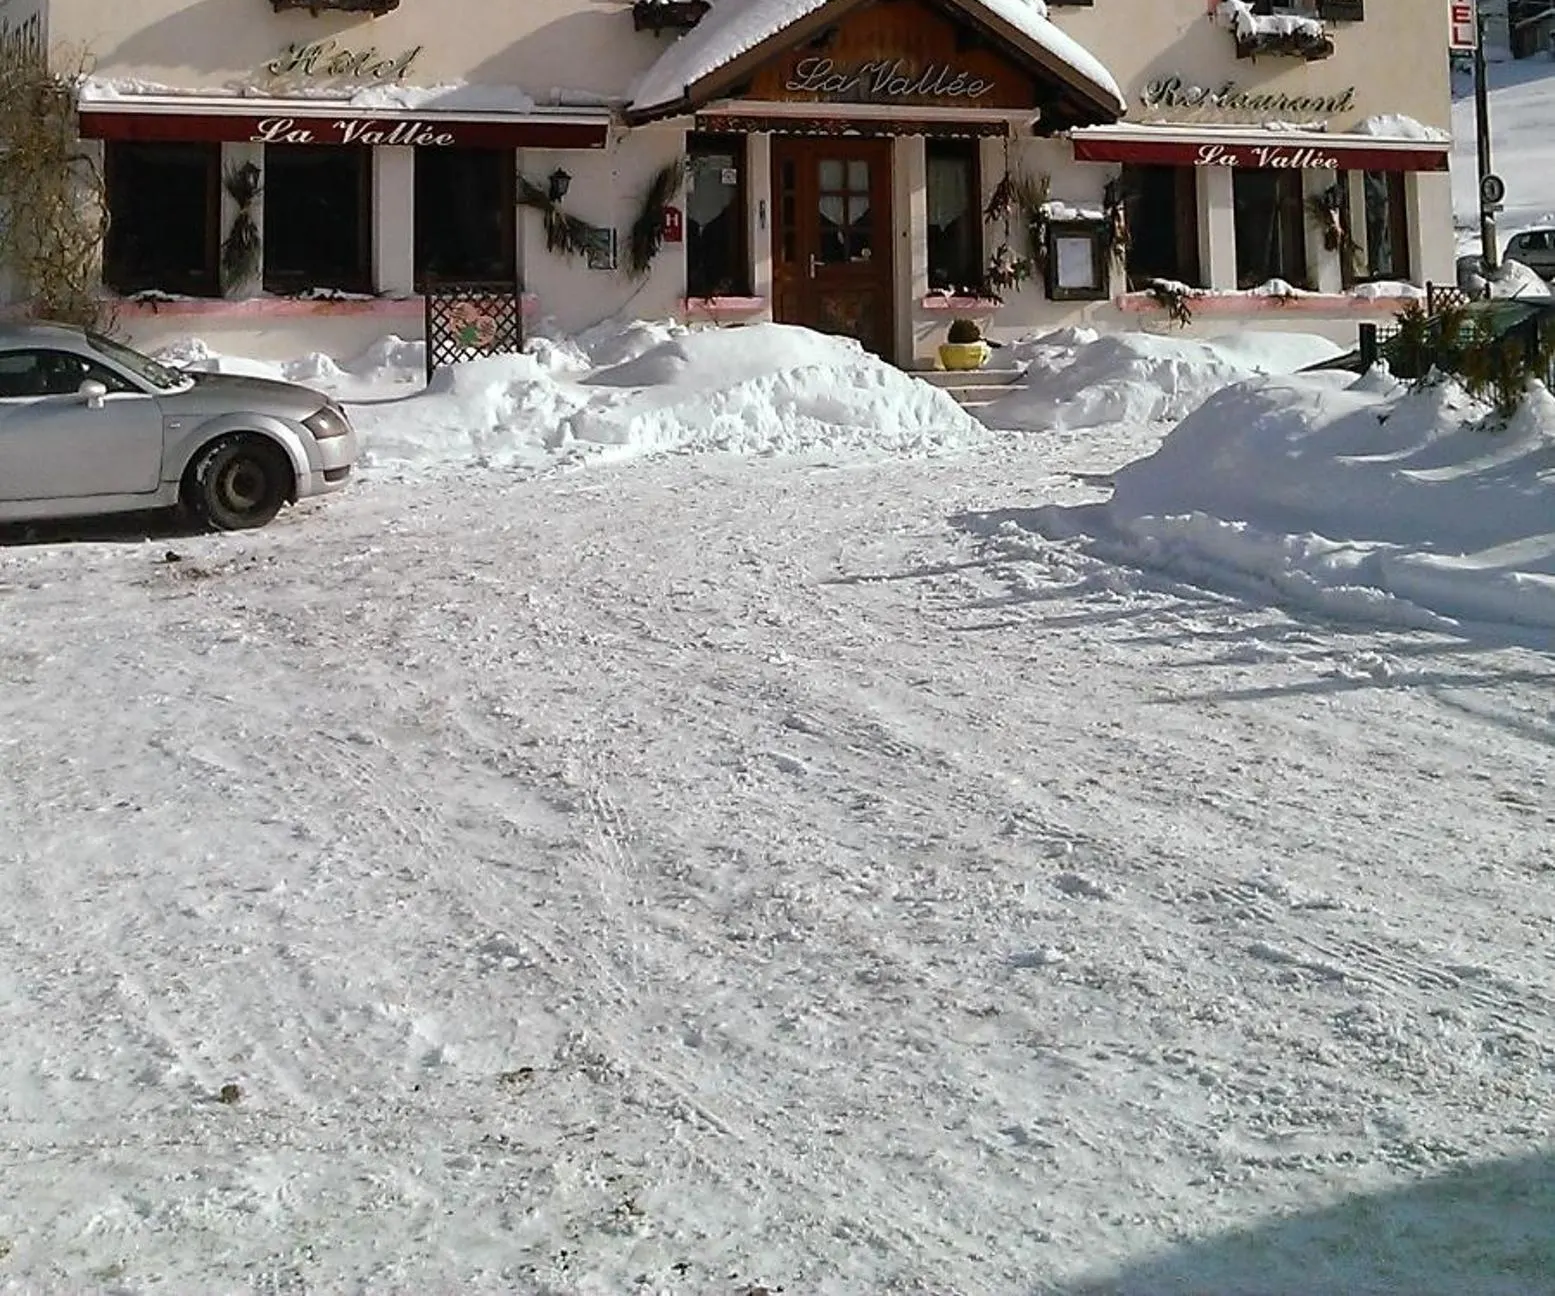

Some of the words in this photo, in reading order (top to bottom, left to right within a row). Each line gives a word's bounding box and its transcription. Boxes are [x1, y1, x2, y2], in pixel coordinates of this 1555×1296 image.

[785, 58, 862, 92] La
[859, 60, 995, 99] Vallée
[250, 117, 315, 144] La
[332, 120, 456, 147] Vallée
[1194, 145, 1239, 167] La
[1251, 147, 1340, 170] Vallée
